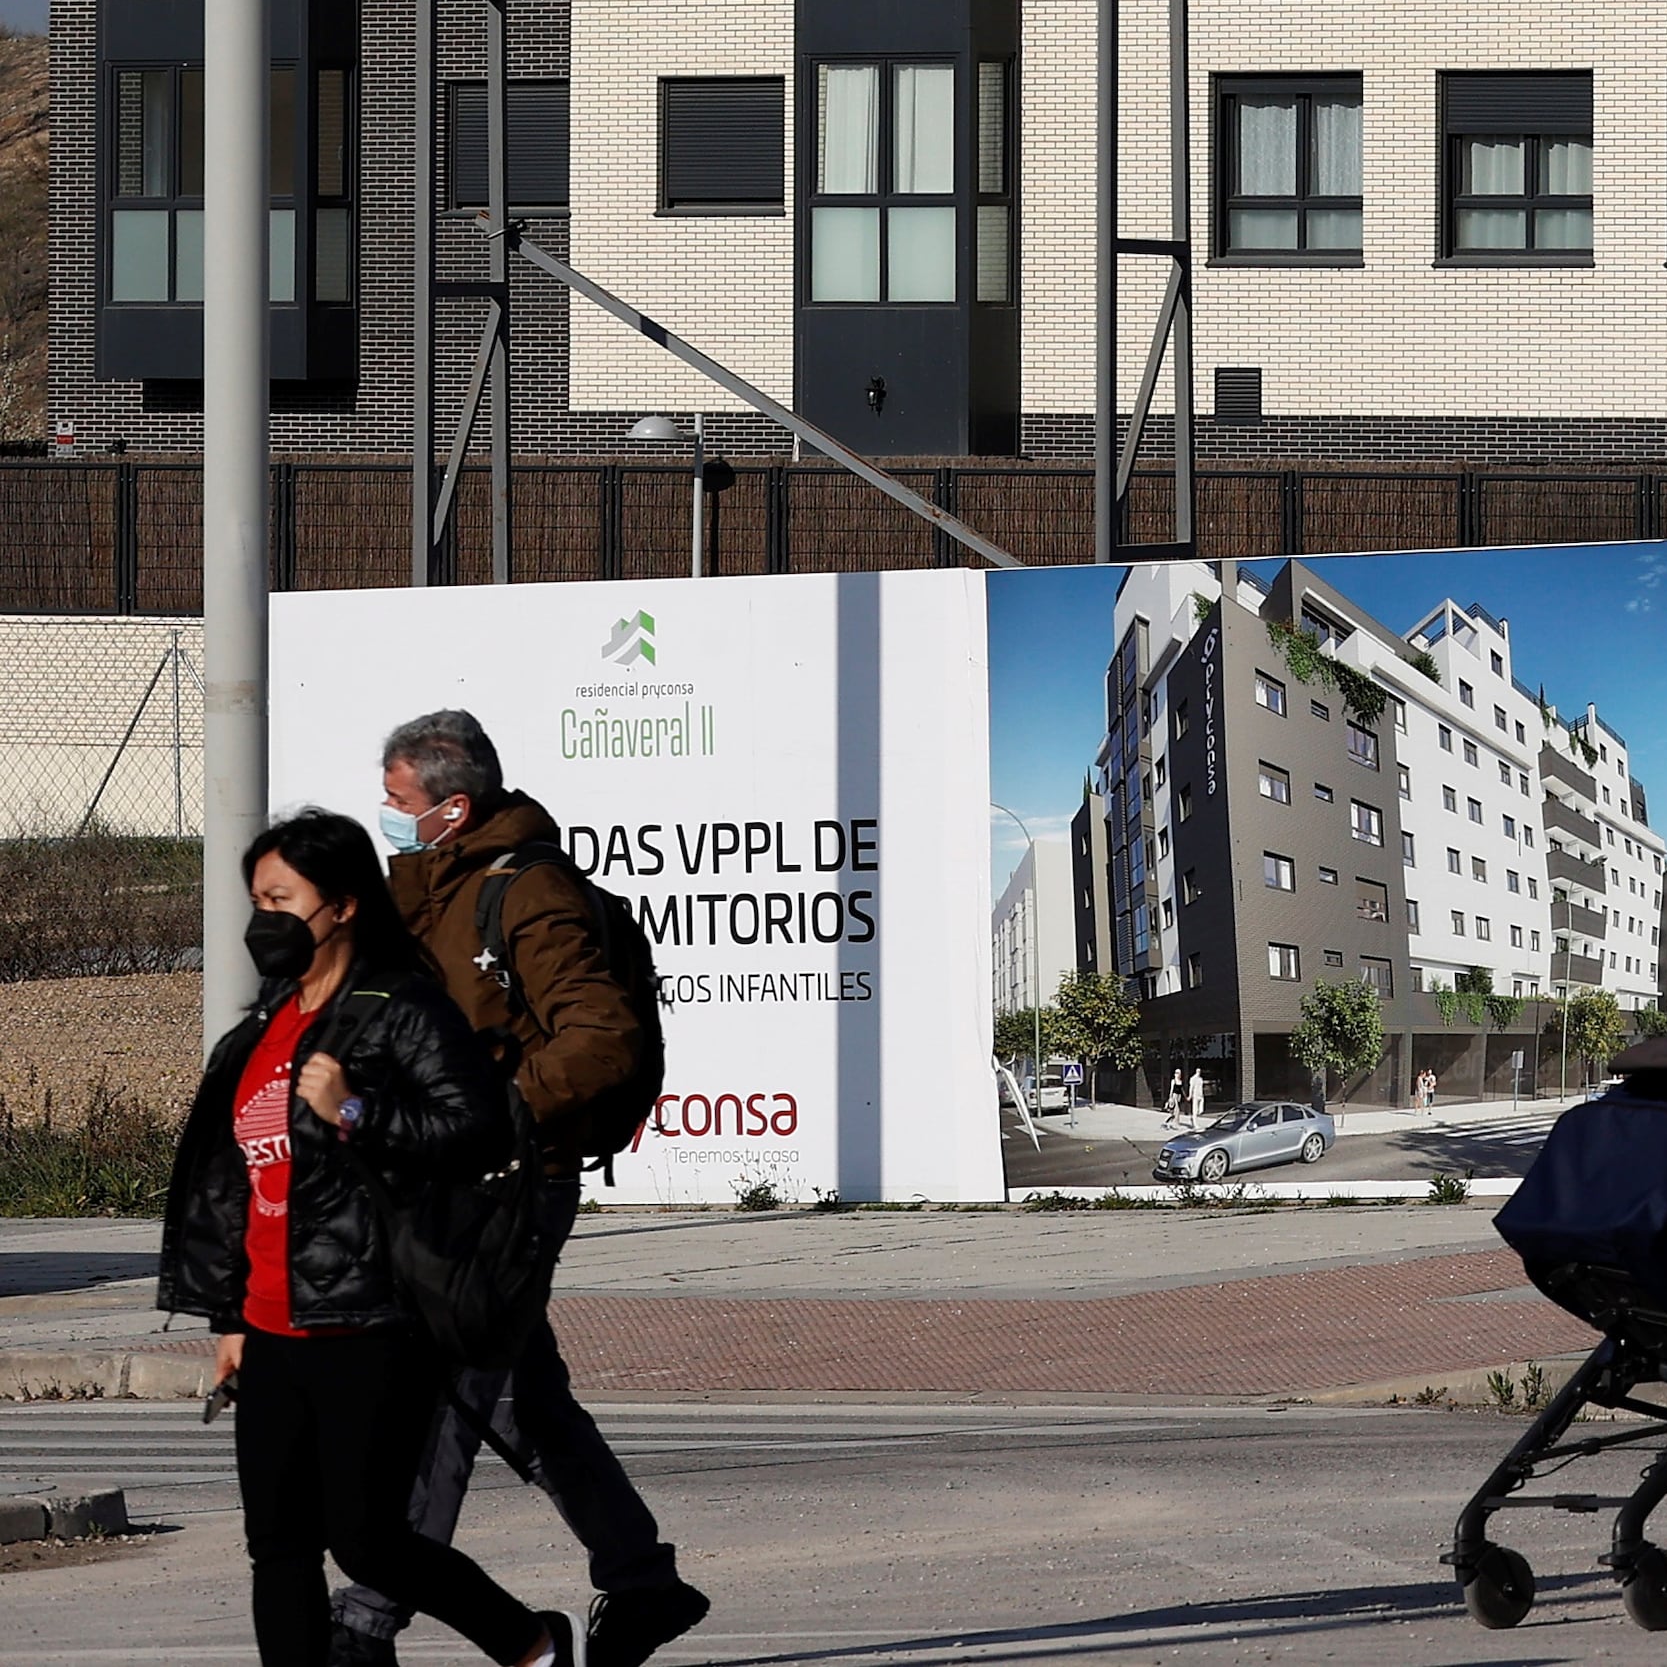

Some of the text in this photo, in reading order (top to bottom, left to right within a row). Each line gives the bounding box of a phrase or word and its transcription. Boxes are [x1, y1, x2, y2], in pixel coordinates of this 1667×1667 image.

[576, 682, 693, 698] residencial pryconsa
[562, 701, 689, 759] Cañaveral
[1205, 663, 1217, 795] pryconsa
[676, 822, 801, 874] VPPL
[813, 819, 879, 872] DE
[640, 890, 876, 946] MITORIOS
[720, 968, 875, 1006] INFANTILES
[631, 1092, 799, 1154] consa
[672, 1147, 799, 1164] Tenemos tu casa
